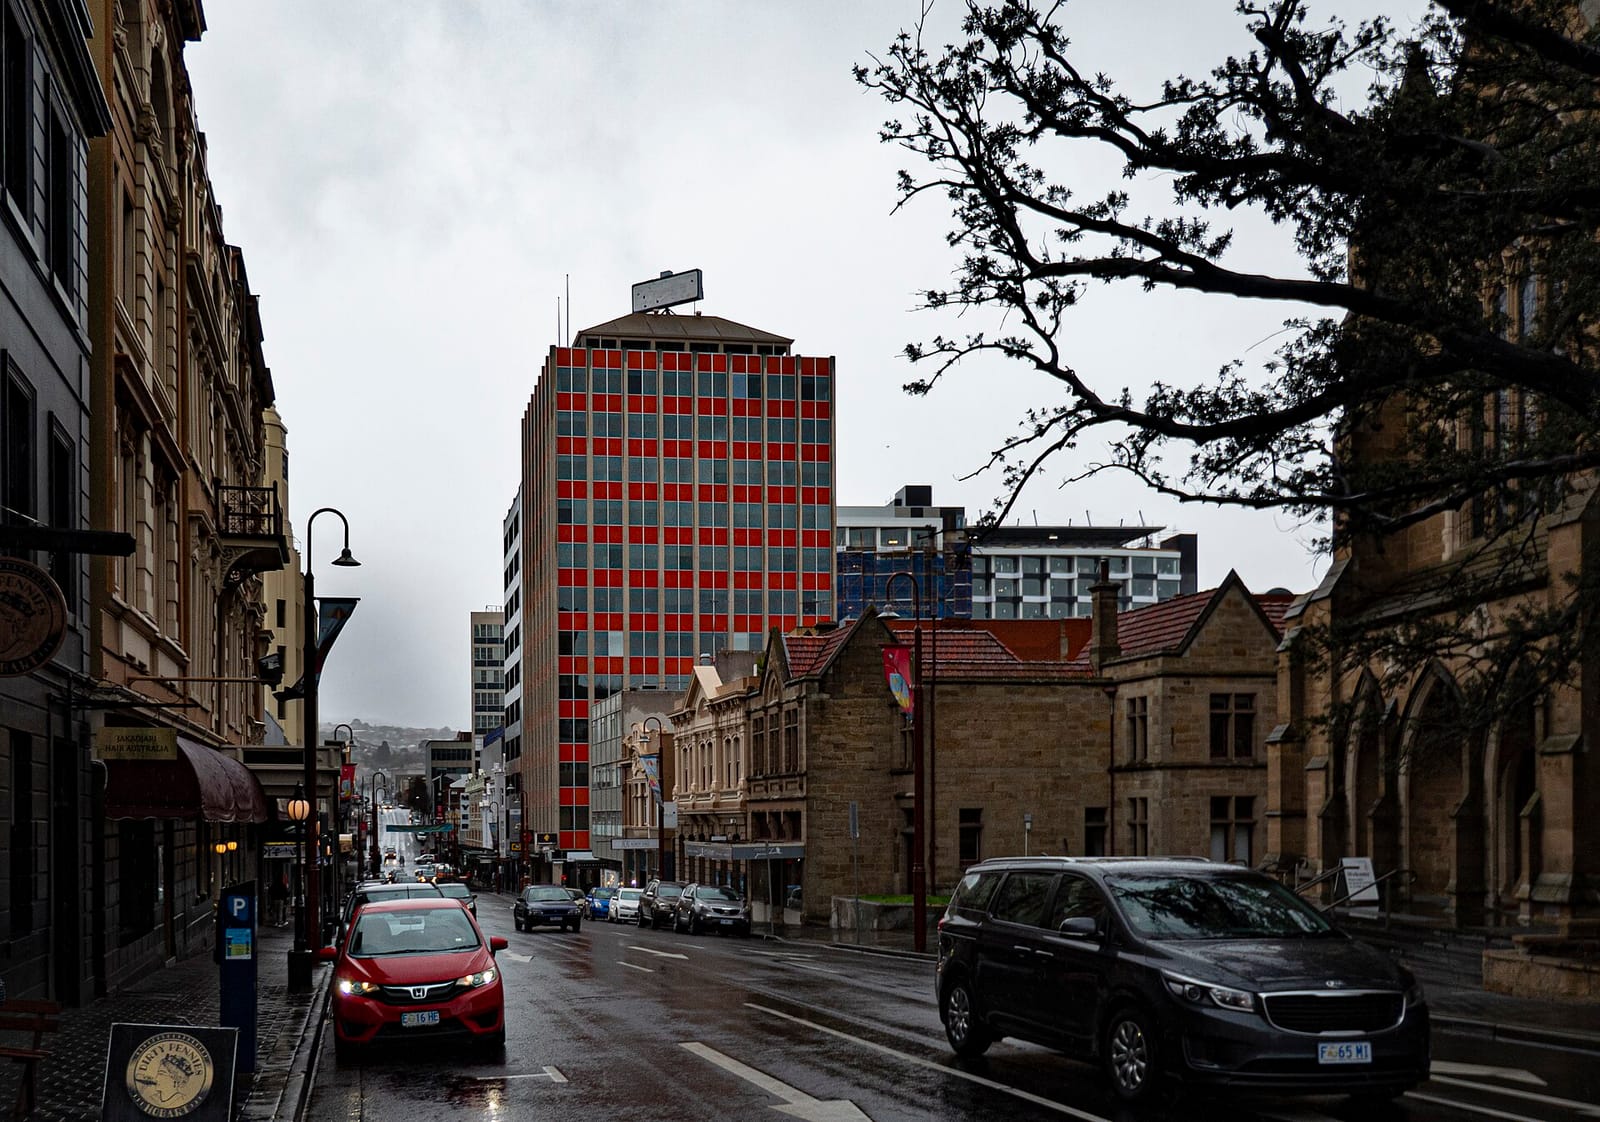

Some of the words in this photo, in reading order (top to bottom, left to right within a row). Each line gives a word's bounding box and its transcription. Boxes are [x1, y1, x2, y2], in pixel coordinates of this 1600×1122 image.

[105, 744, 125, 752] HAIR
[126, 744, 169, 752] AUSTRALIA
[461, 794, 470, 830] MYER
[233, 898, 246, 917] P
[139, 1045, 165, 1072] DIRTY
[169, 1043, 203, 1076] PENNIES
[143, 1104, 189, 1118] HOBART
